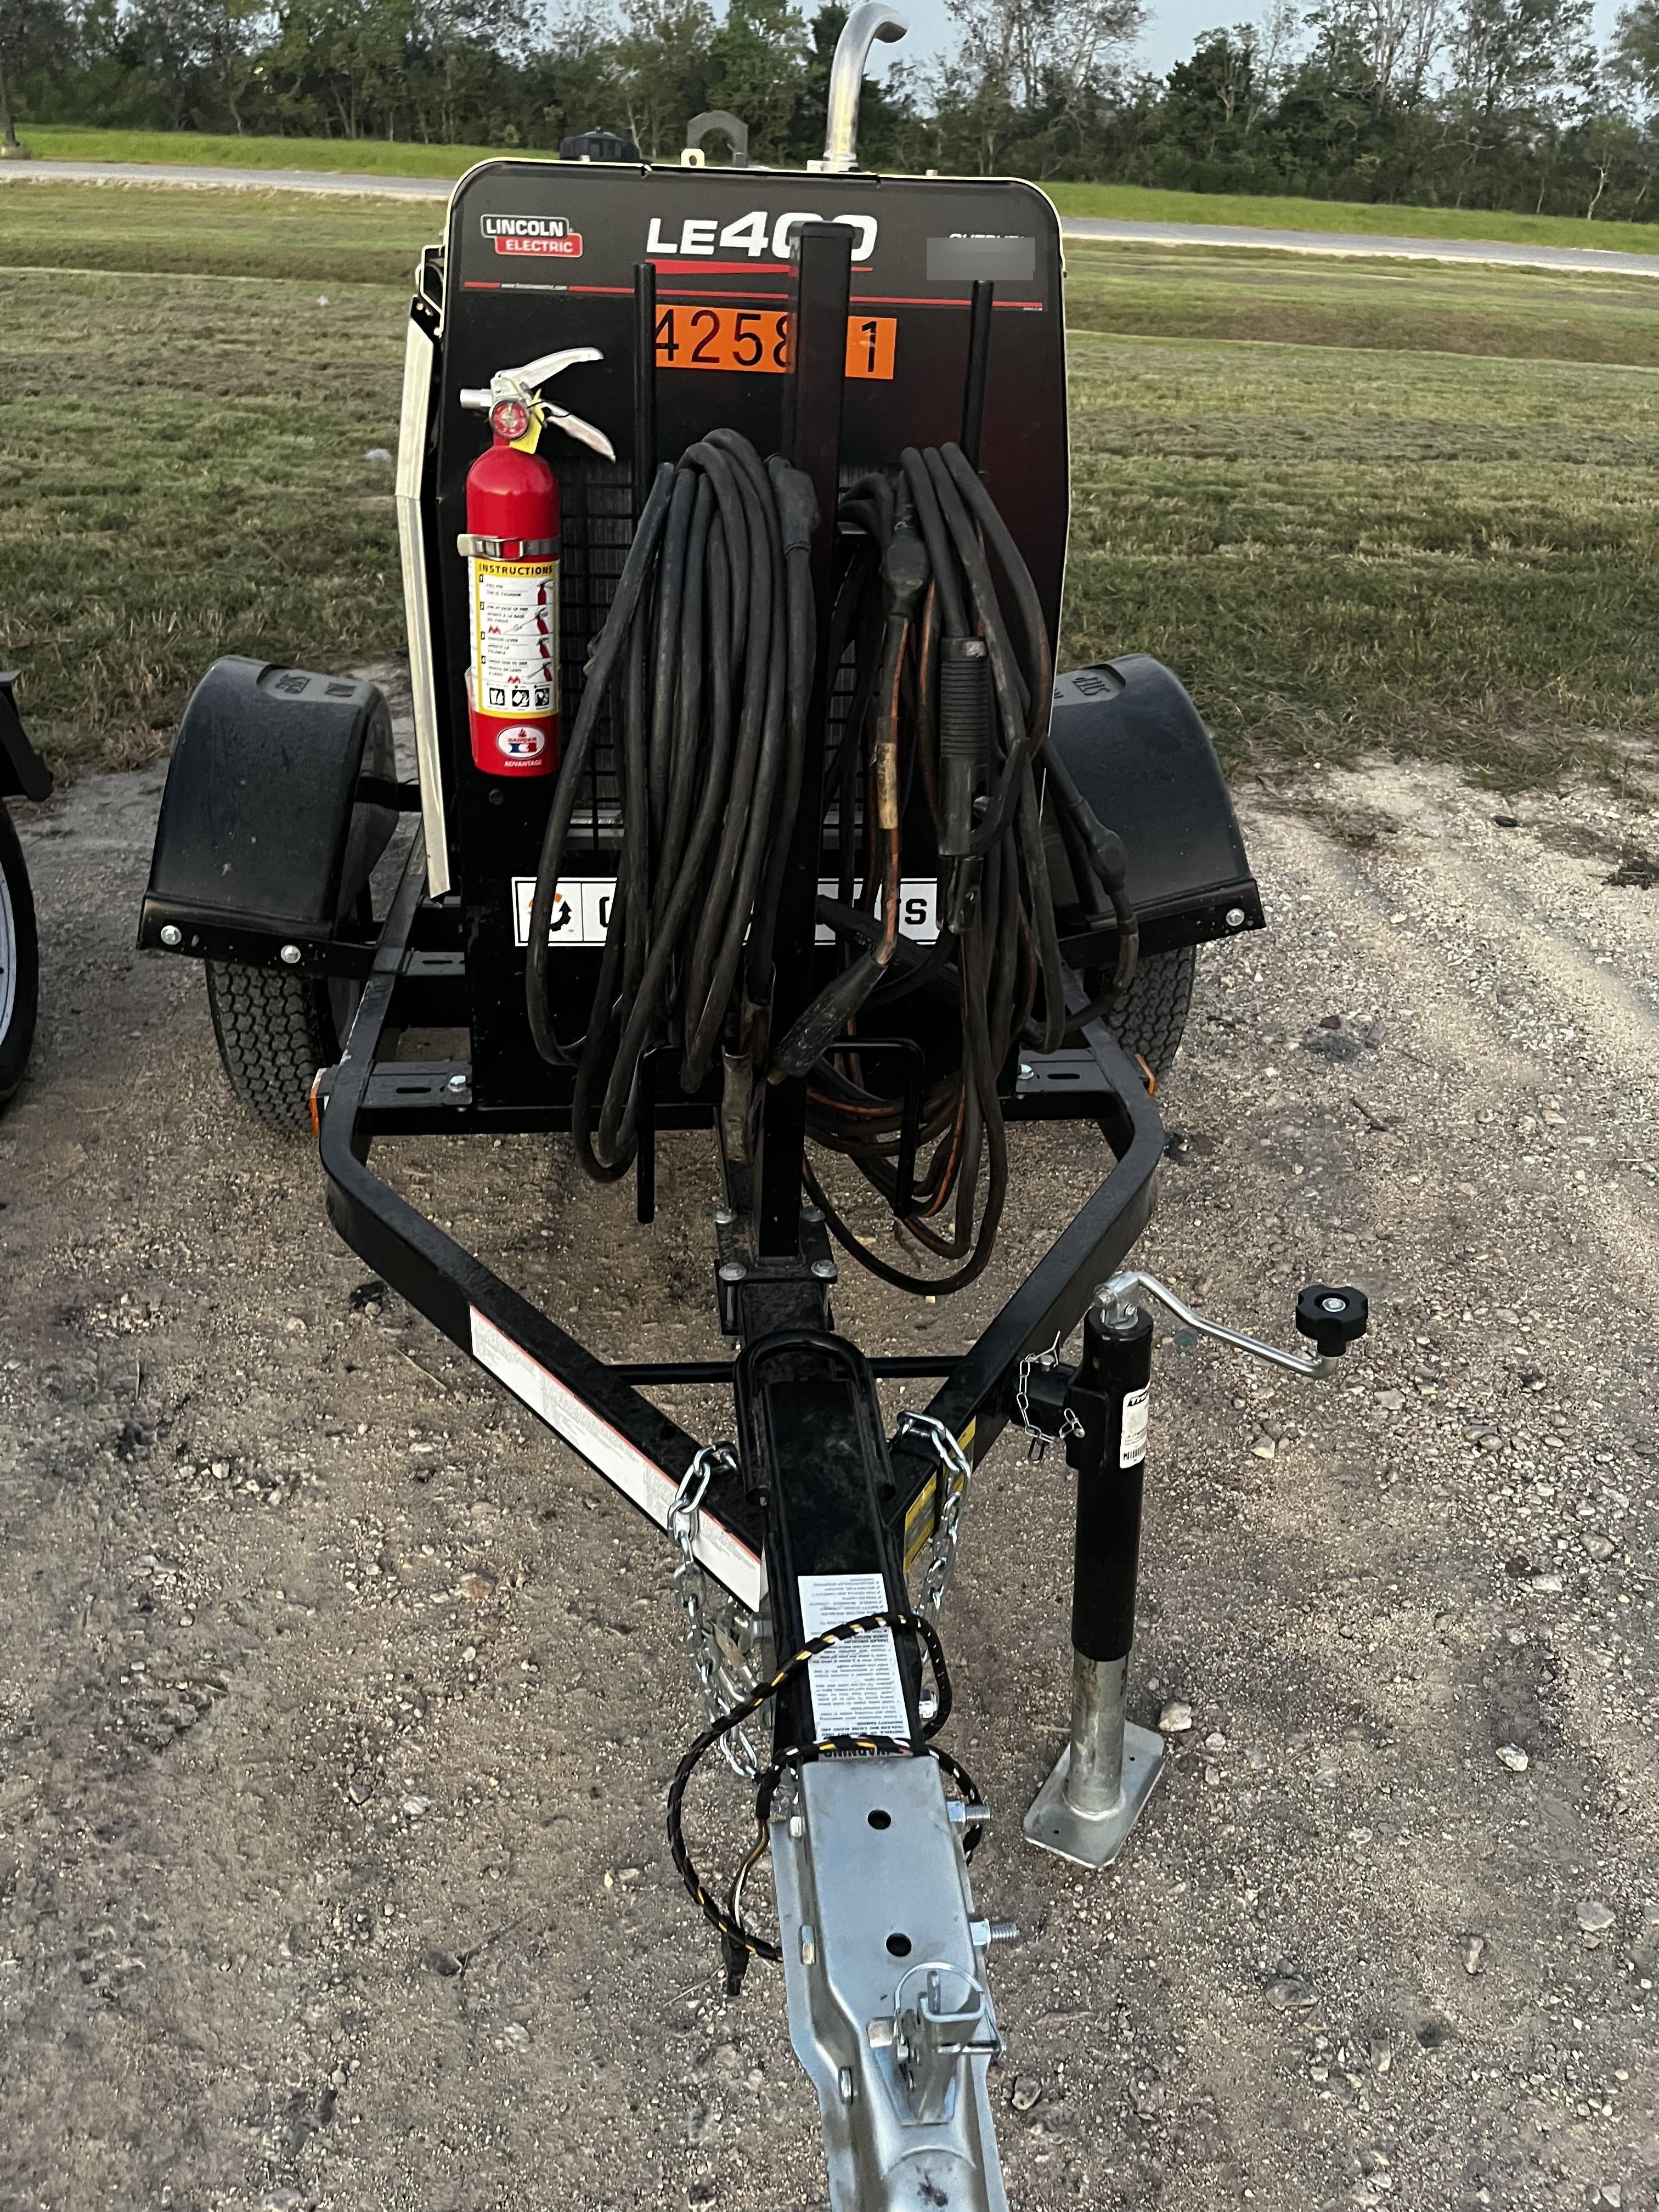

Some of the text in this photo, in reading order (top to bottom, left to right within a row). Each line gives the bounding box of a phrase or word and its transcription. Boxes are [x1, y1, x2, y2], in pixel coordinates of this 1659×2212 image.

[486, 218, 563, 237] LINCOLN
[505, 239, 573, 253] ELECTRIC
[655, 309, 877, 373] 42581
[479, 563, 553, 575] INSTRUCTIONS
[504, 759, 543, 767] ADVANTAGE
